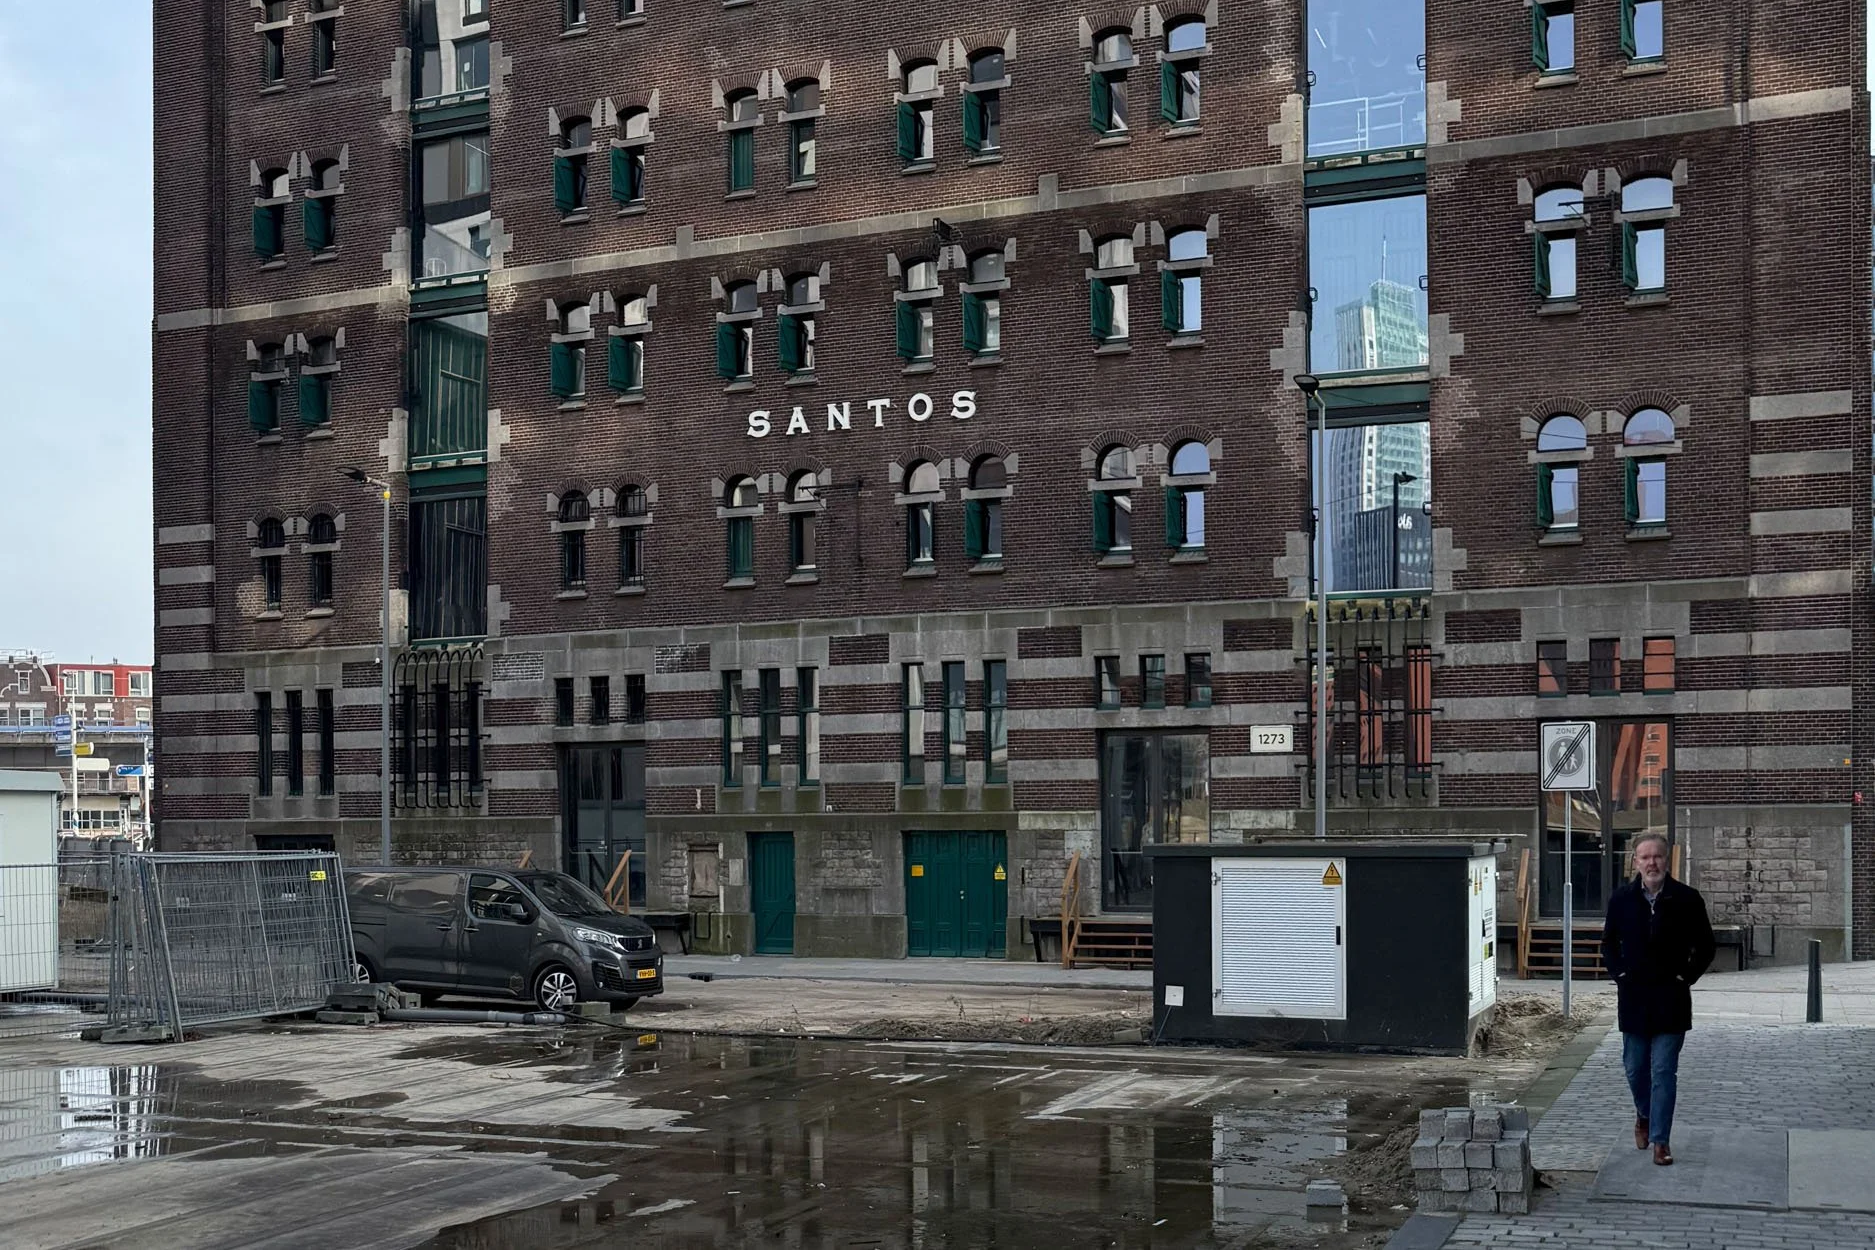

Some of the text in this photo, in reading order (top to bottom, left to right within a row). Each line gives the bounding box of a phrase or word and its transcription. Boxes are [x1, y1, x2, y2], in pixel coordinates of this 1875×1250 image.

[746, 390, 977, 438] SANTOS
[1555, 727, 1577, 735] ZONE
[1258, 733, 1285, 745] 1273
